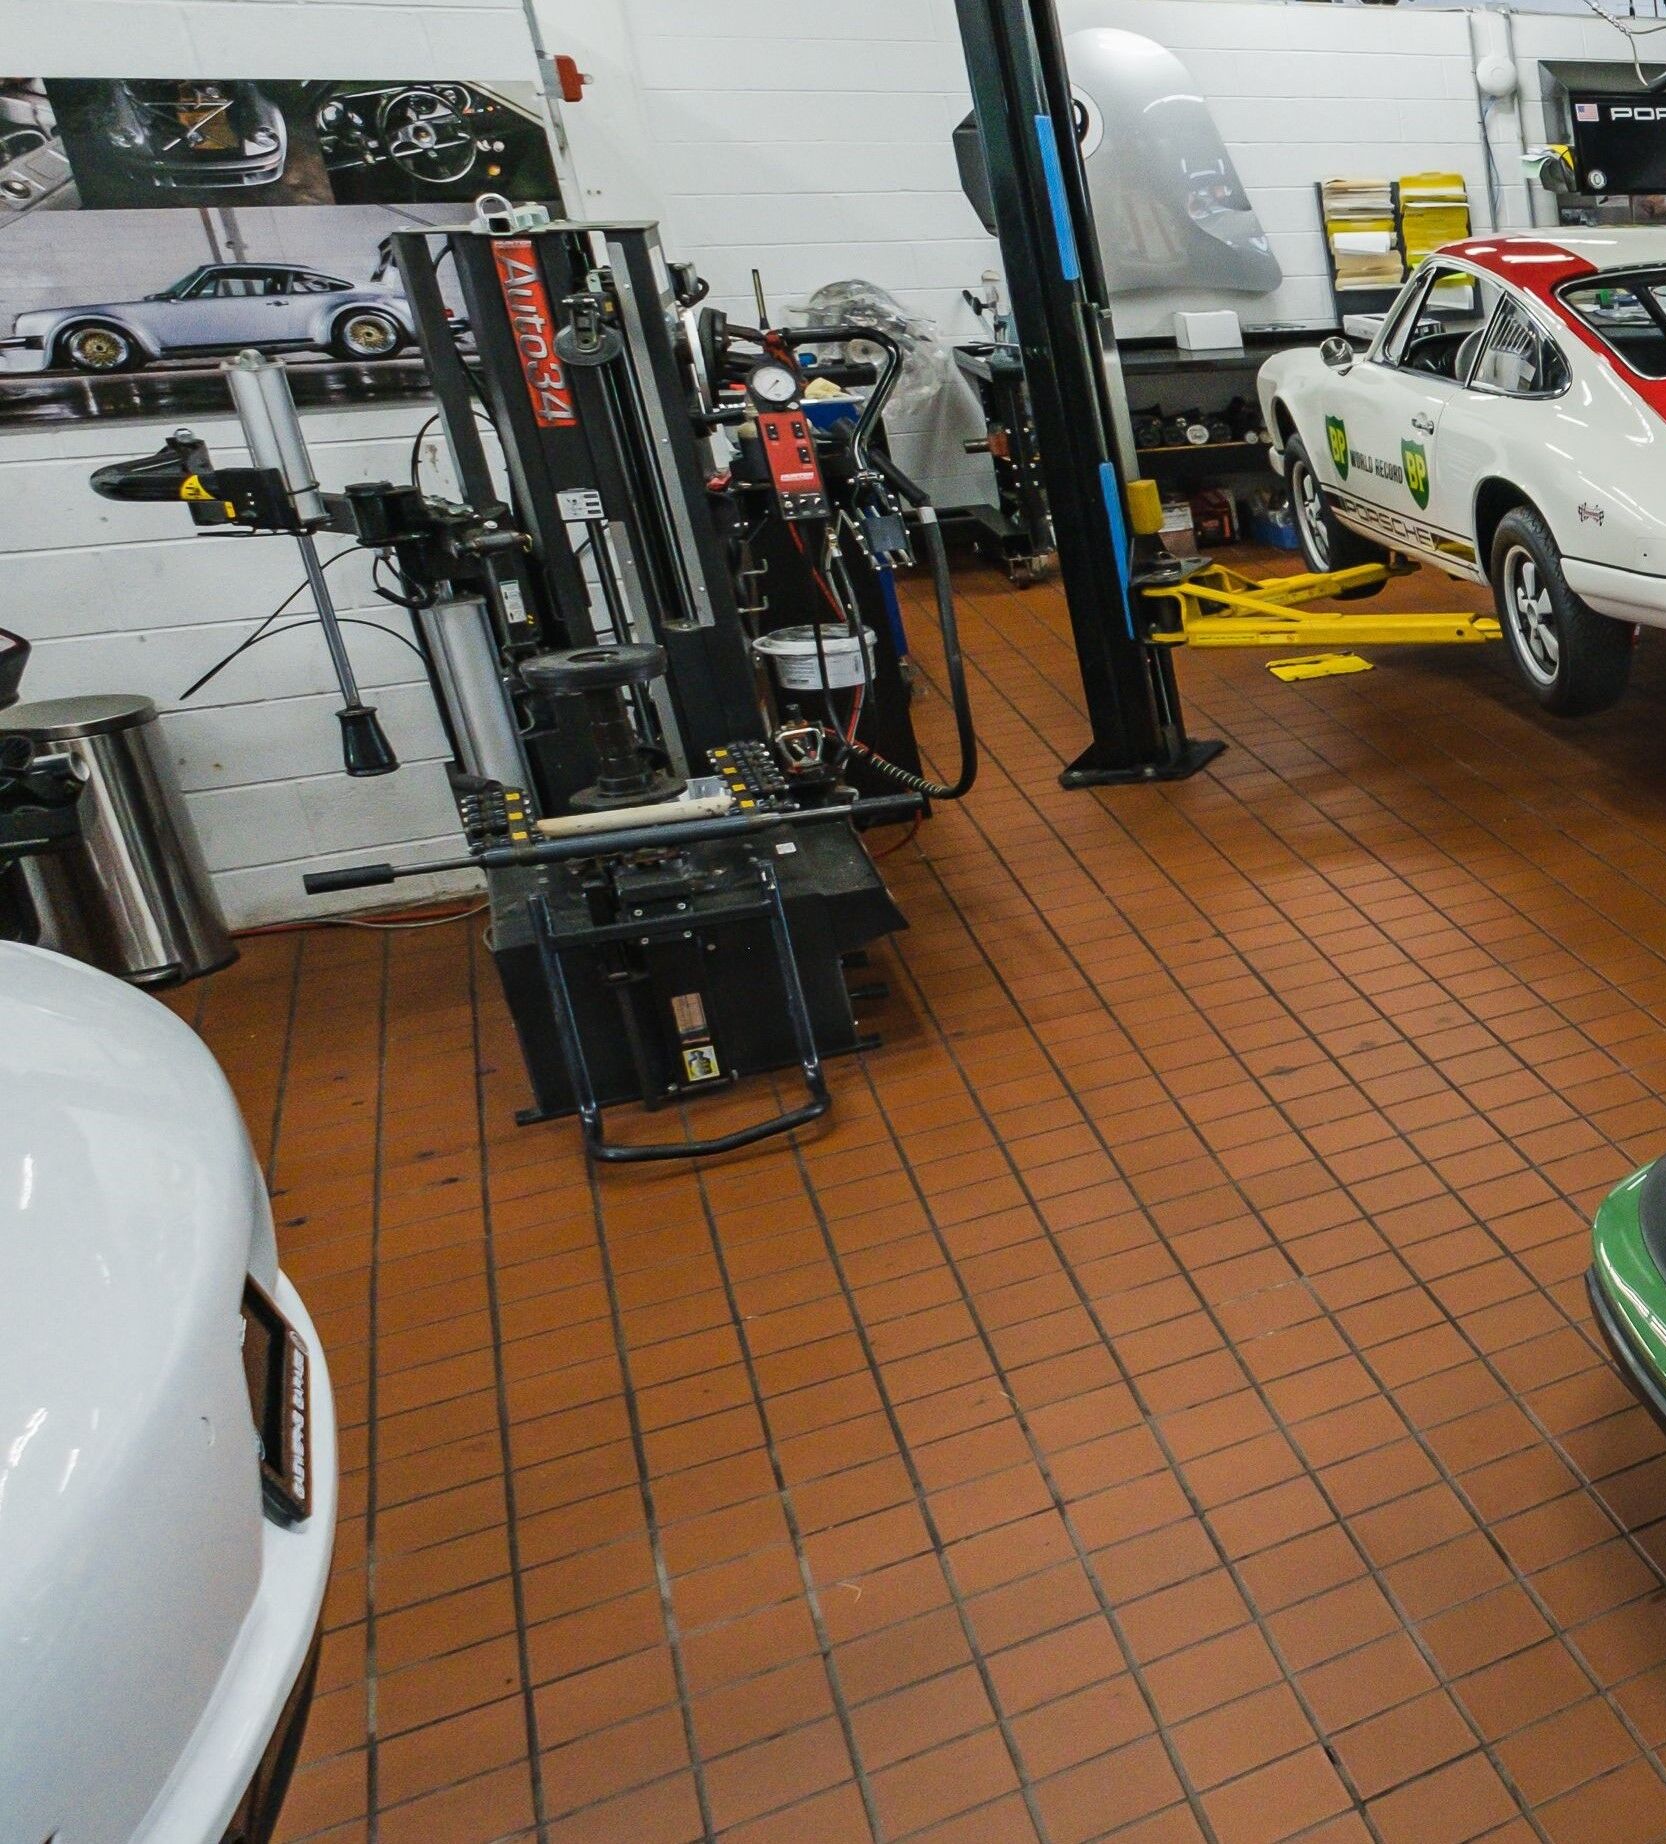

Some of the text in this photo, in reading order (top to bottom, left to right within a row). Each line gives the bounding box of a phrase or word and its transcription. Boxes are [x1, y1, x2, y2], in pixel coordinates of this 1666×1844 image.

[502, 256, 575, 421] Auto34
[1328, 425, 1347, 464] BP
[1350, 449, 1403, 485] WORLD RECORD
[1404, 450, 1426, 493] BP
[1342, 499, 1433, 549] PORSCHE
